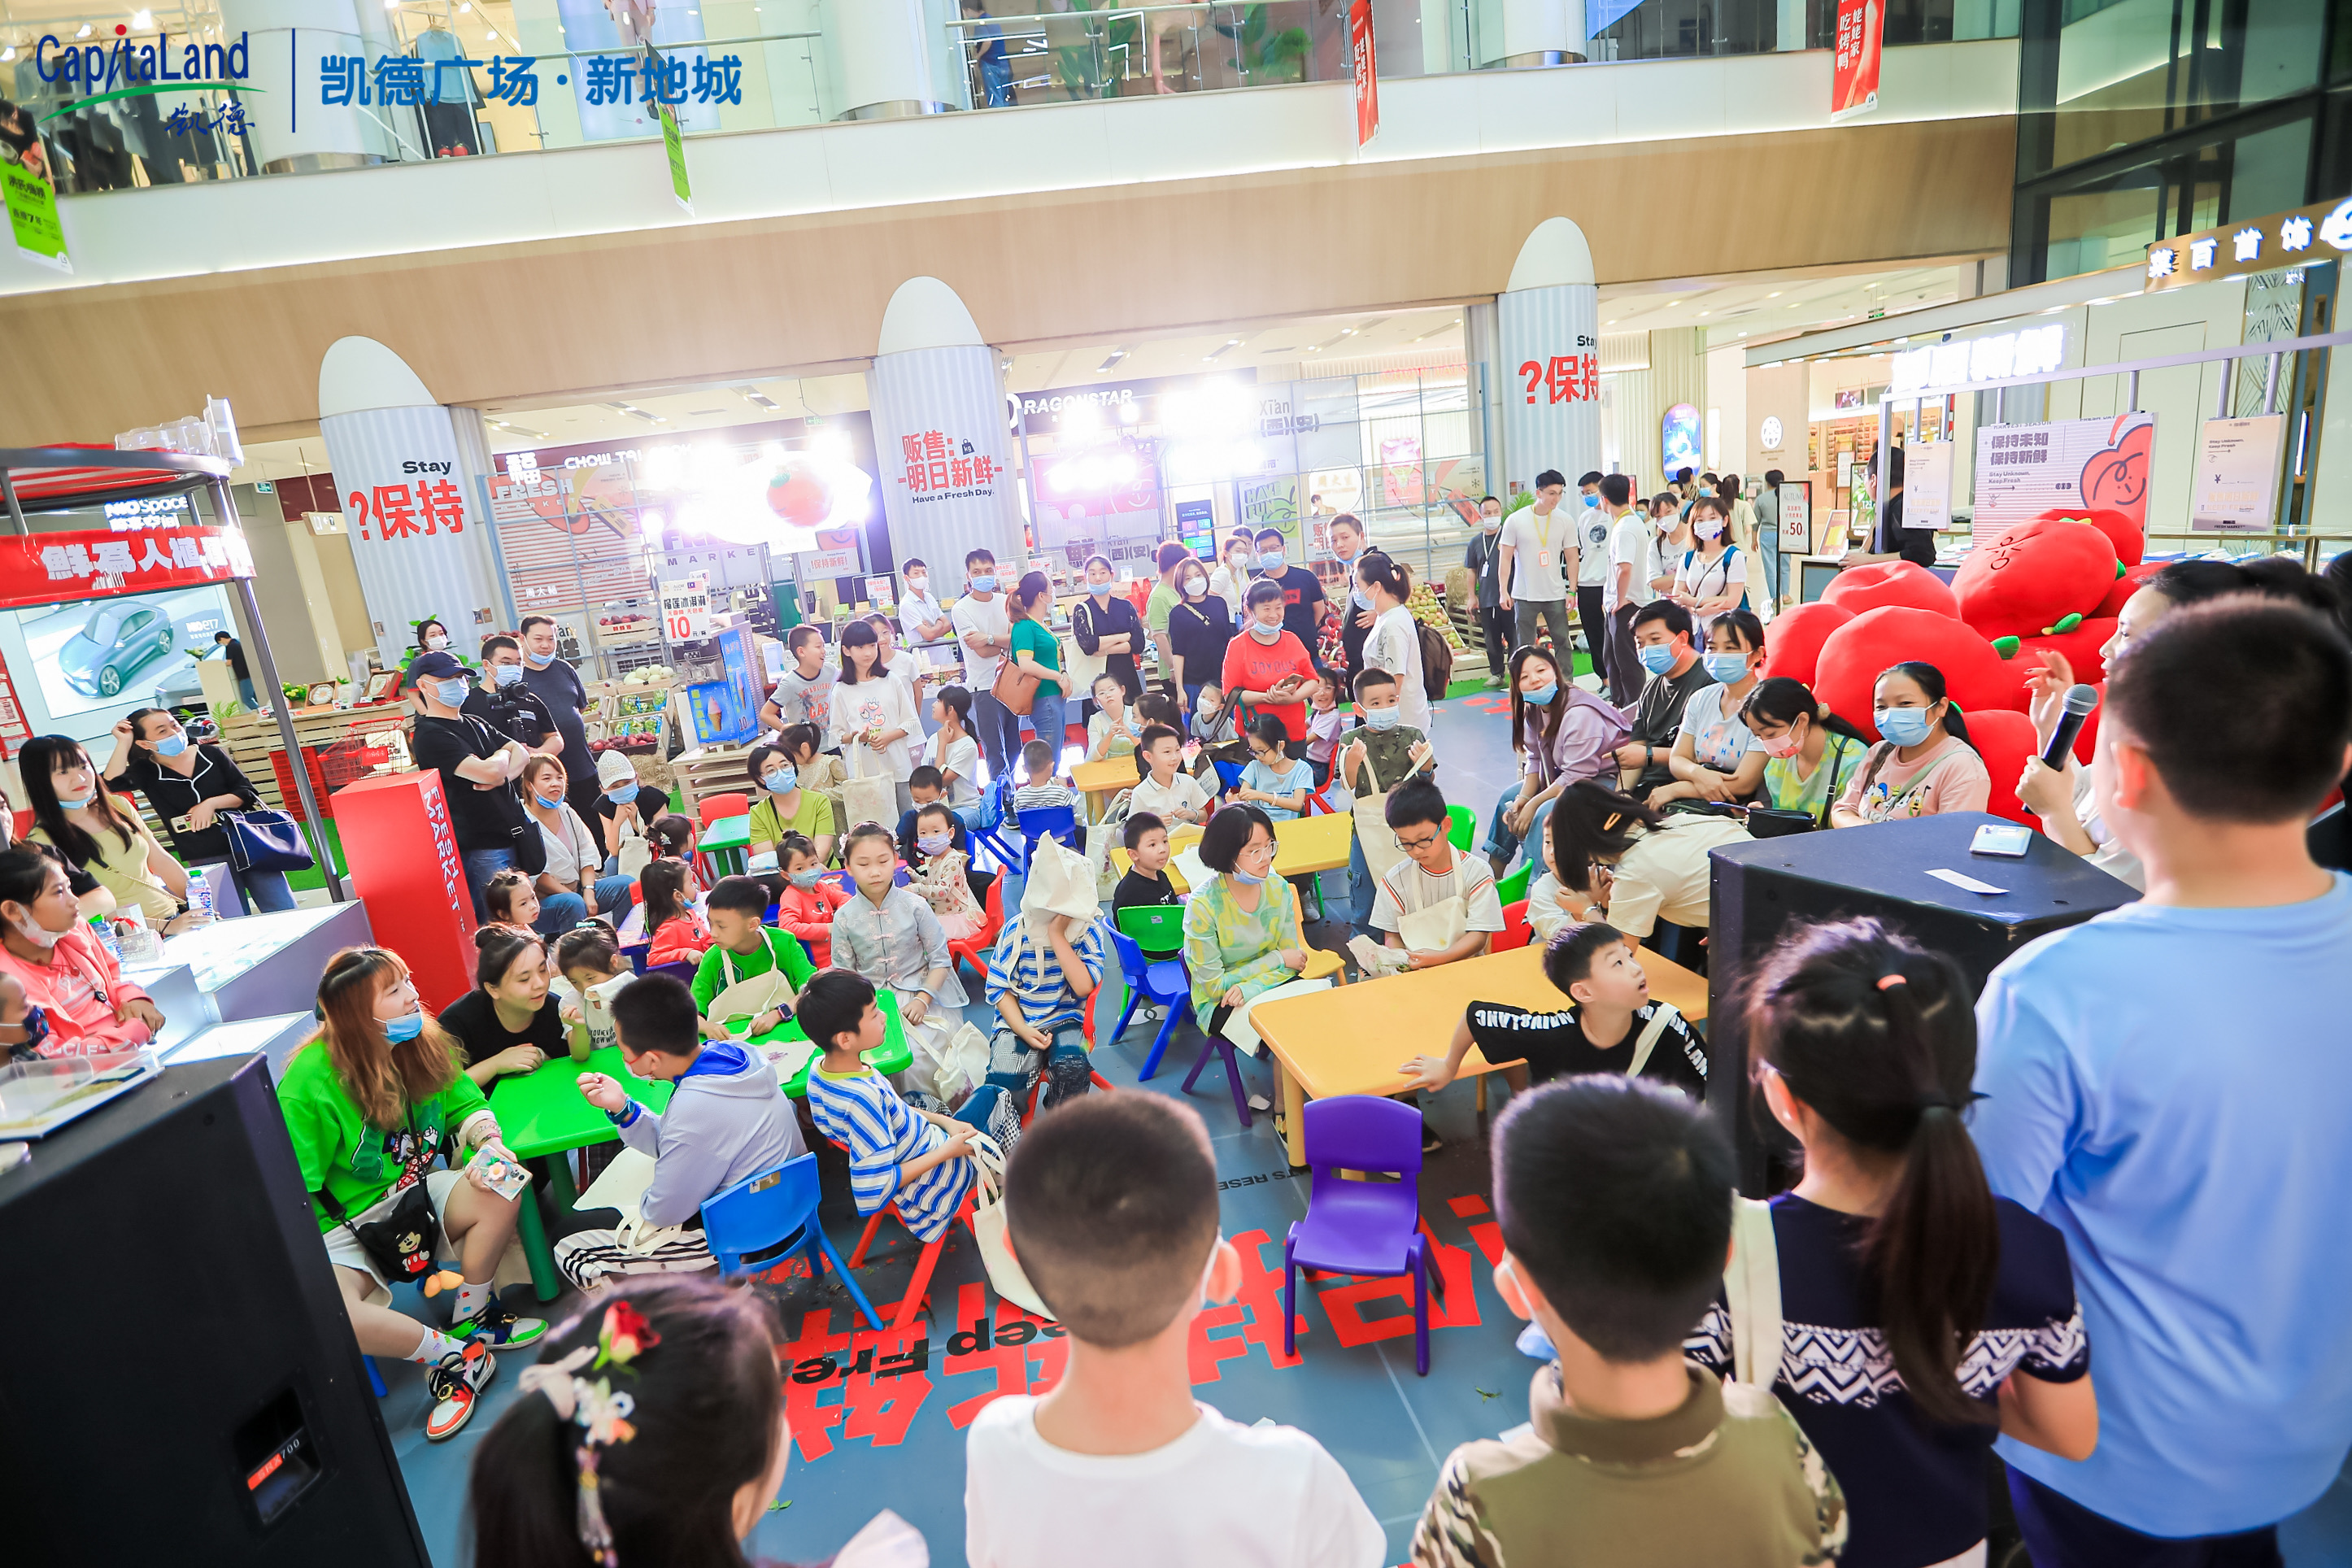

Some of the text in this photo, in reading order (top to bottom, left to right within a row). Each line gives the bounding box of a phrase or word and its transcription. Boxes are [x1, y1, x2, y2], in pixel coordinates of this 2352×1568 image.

[1837, 13, 1852, 72] 吃烤鸭
[1849, 7, 1863, 59] 姥姥家
[403, 460, 451, 476] Stay
[564, 453, 612, 470] CHOW
[494, 477, 575, 501] FRESH
[912, 494, 936, 503] Have
[937, 493, 944, 501] a
[944, 489, 974, 499] Fresh
[1244, 481, 1283, 504] HAVE
[349, 479, 464, 541] ?保持
[1246, 499, 1277, 520] FUN
[1790, 522, 1803, 536] 50
[668, 548, 756, 567] MARKE
[667, 616, 690, 639] 10
[431, 786, 460, 879] FRESH
[424, 792, 461, 912] MARKET
[281, 1439, 300, 1459] 700
